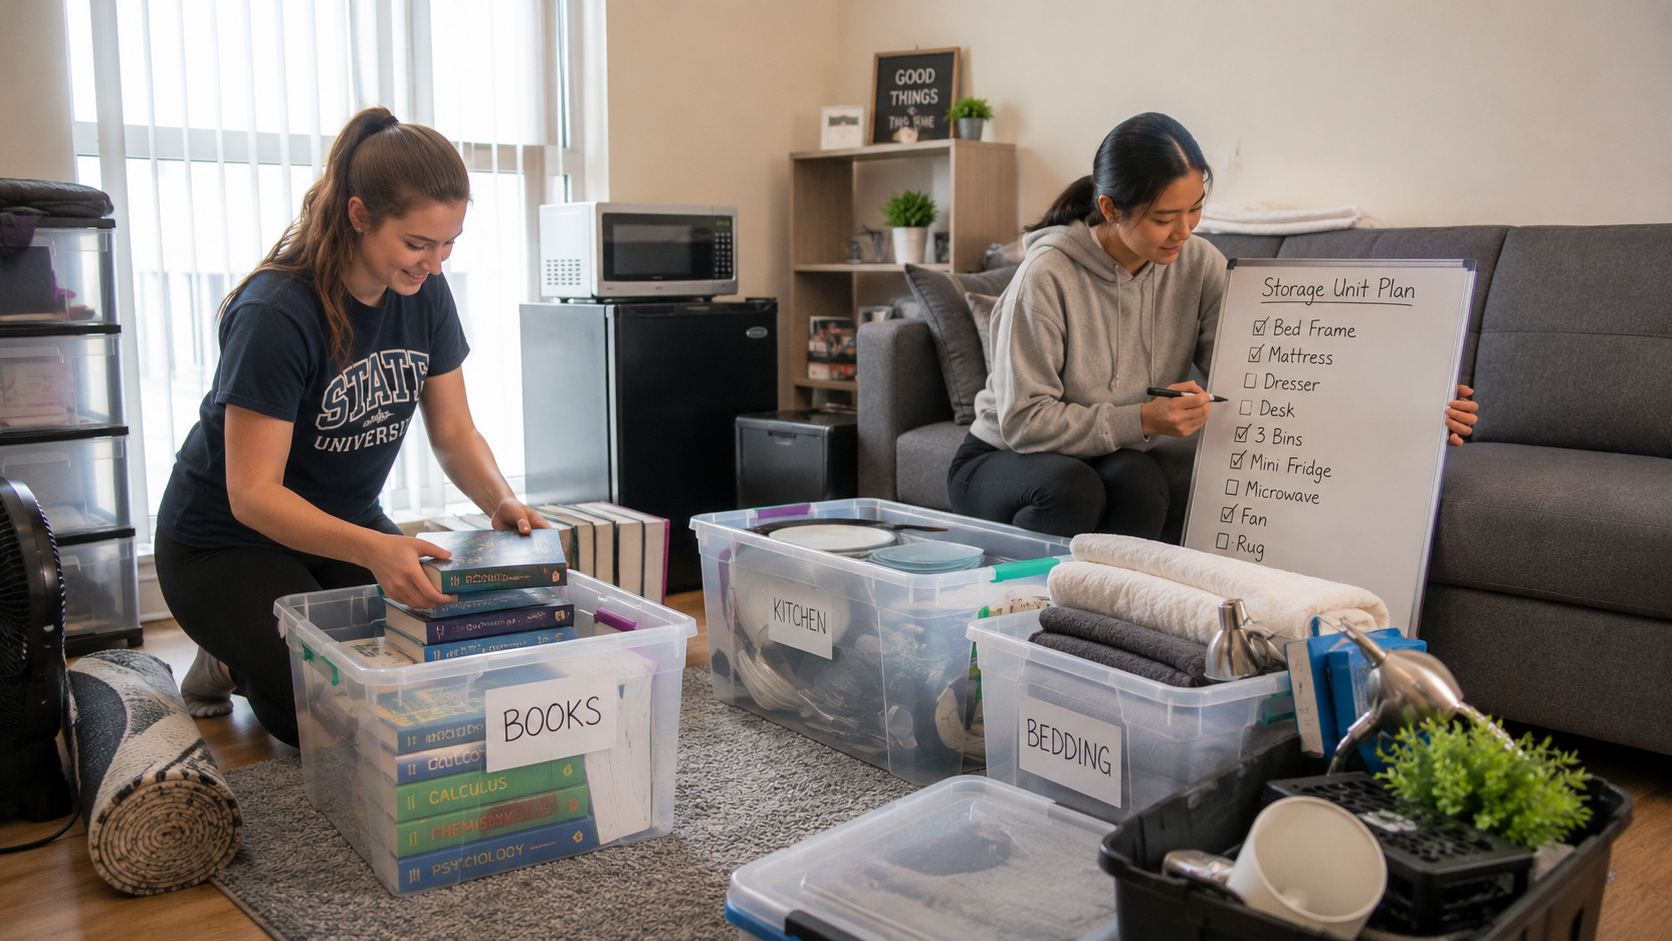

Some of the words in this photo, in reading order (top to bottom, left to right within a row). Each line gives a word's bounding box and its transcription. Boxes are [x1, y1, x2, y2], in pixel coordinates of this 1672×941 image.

[895, 67, 936, 85] GOOD
[889, 88, 939, 106] THINGS
[1261, 276, 1325, 306] Storage
[1333, 277, 1370, 298] Unit
[1377, 277, 1415, 299] Plan
[1273, 318, 1302, 337] Bed
[1308, 319, 1357, 338] Frame
[1268, 346, 1334, 365] Mattress
[1263, 372, 1320, 392] Dresser
[1259, 399, 1296, 418] Desk
[1254, 426, 1266, 444] 3
[1272, 427, 1303, 447] Bins
[1249, 453, 1279, 472] Mini
[1287, 456, 1332, 484] Fridge
[1245, 480, 1320, 505] Microwave
[1241, 507, 1267, 527] Fan
[1236, 534, 1265, 563] Rug
[773, 597, 827, 635] KITCHEN
[503, 695, 602, 743] BOOKS
[1027, 718, 1112, 777] BEDDING
[428, 776, 508, 805] CALCULUS
